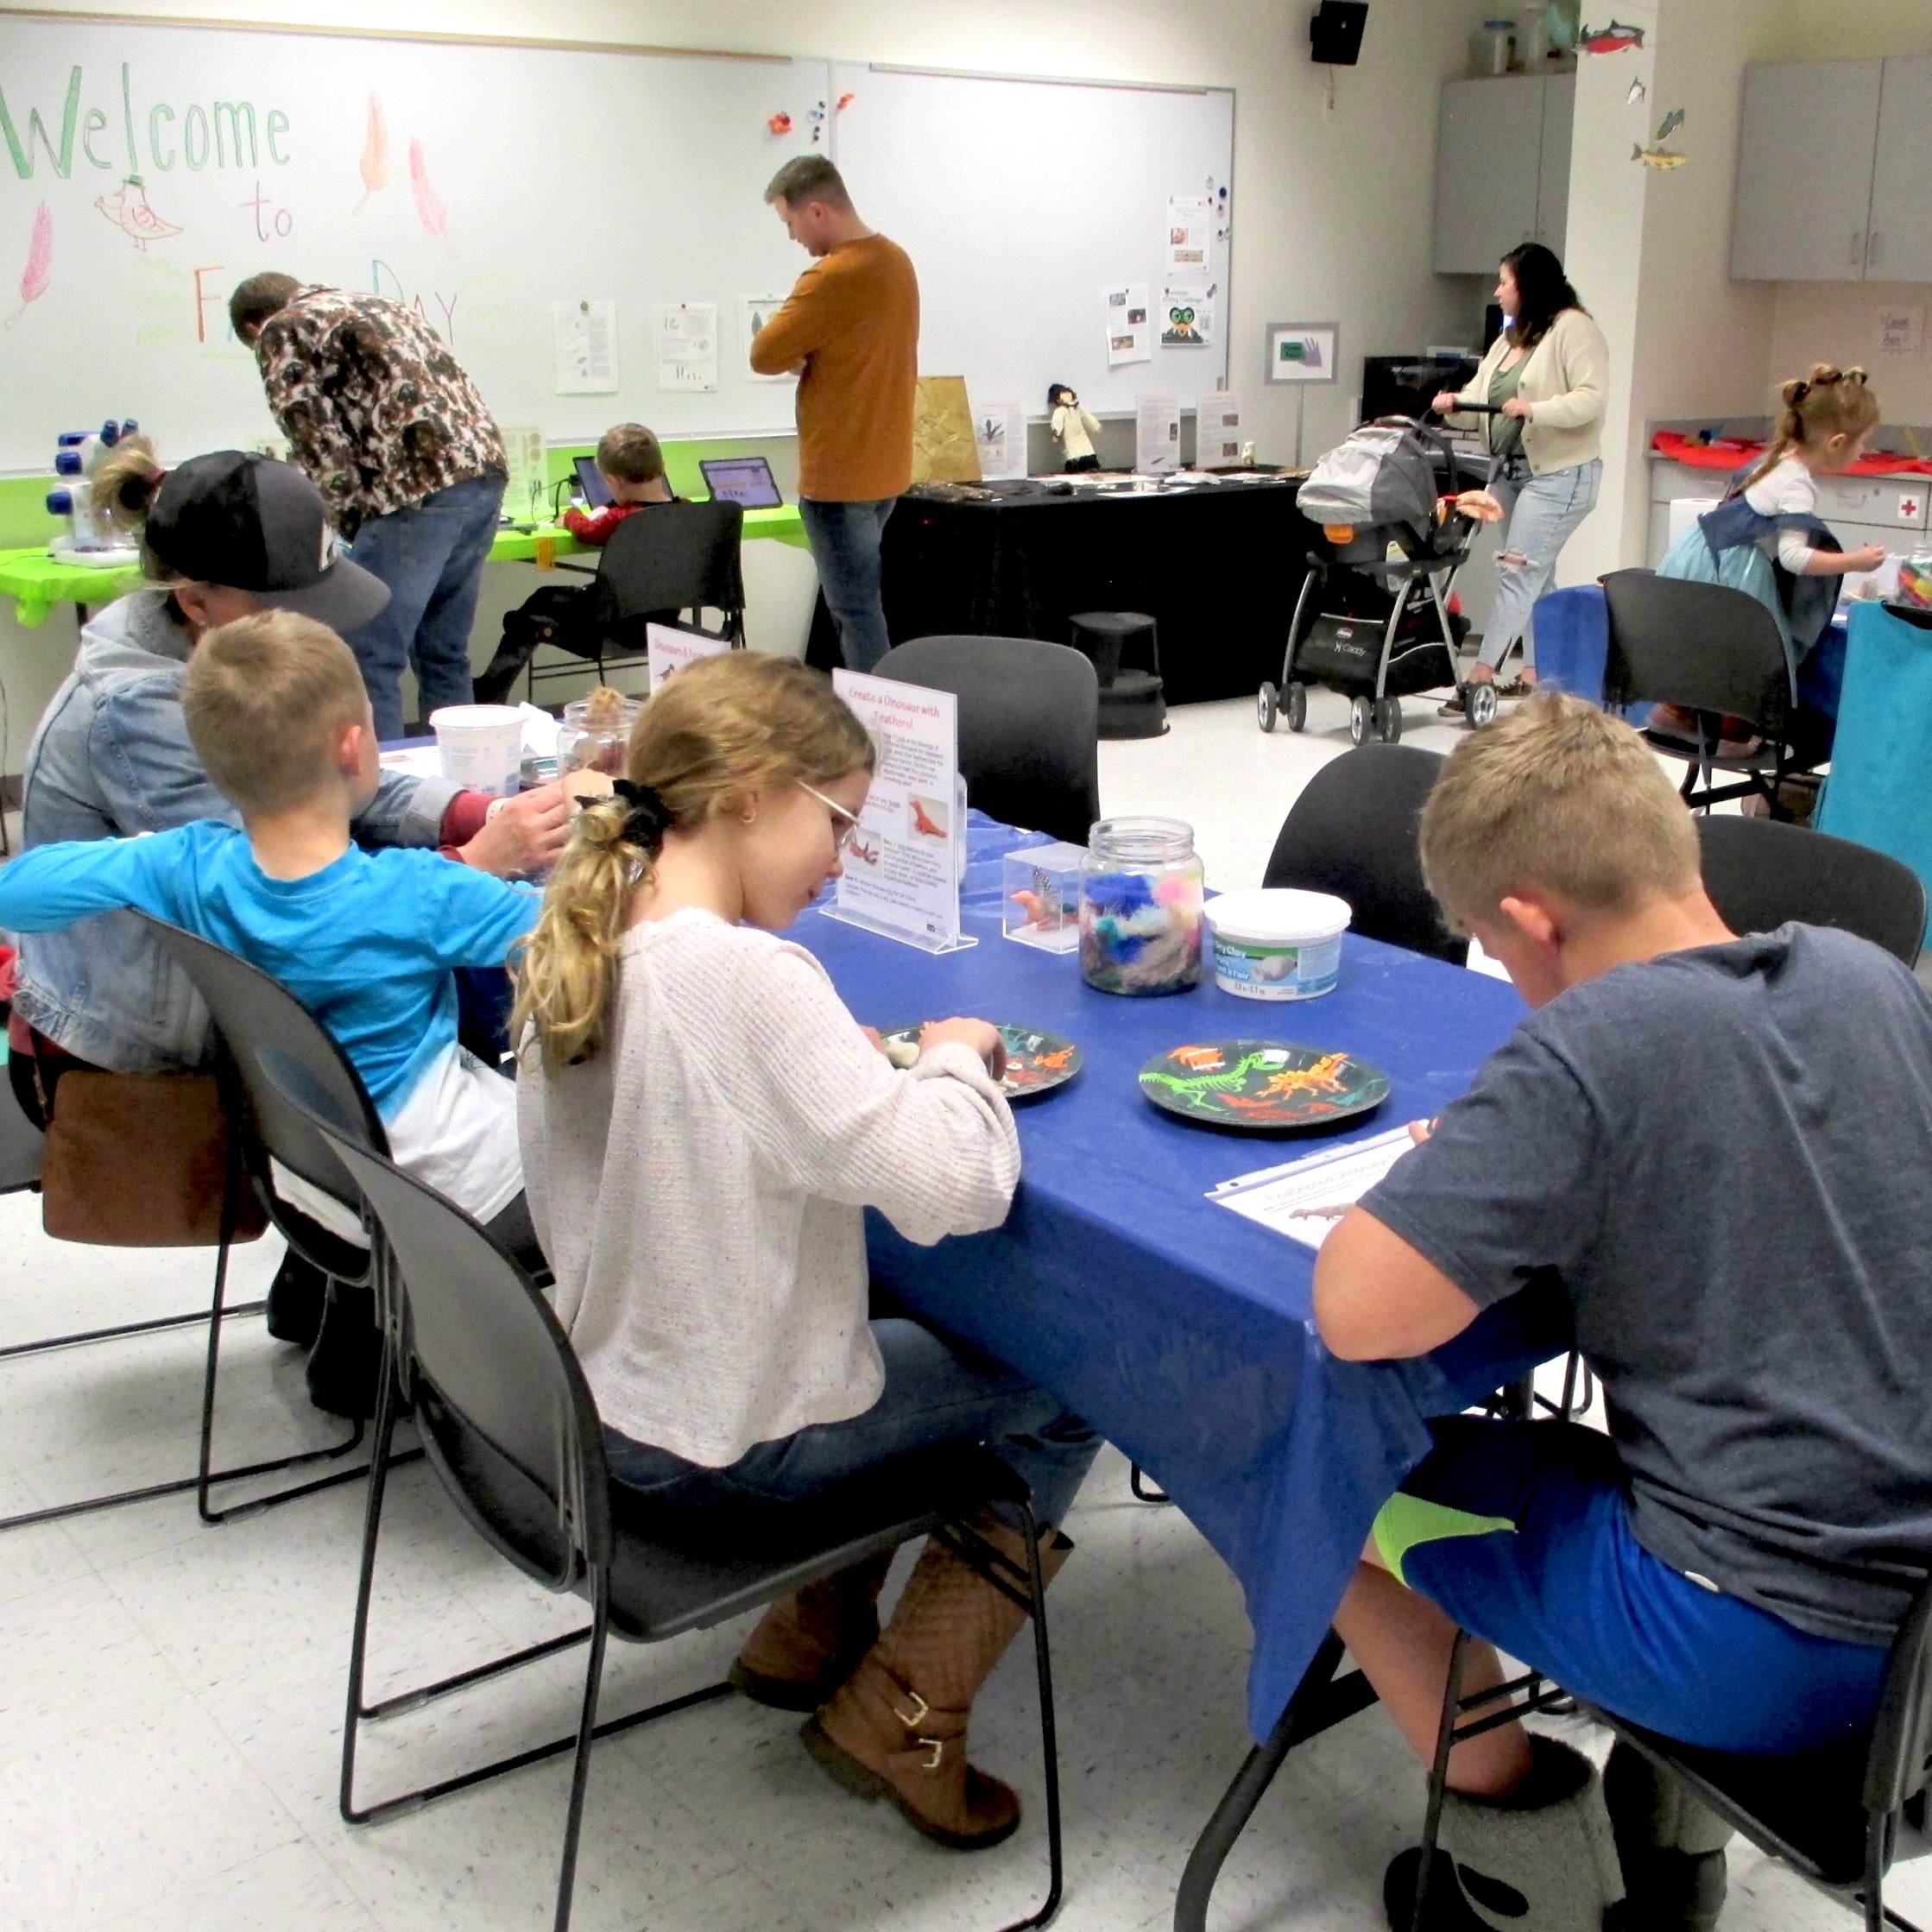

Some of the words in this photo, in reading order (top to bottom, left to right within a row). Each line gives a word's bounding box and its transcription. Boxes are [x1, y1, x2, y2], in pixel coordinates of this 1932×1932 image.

[0, 61, 291, 180] Welcome
[239, 180, 293, 243] to
[849, 686, 876, 704] Create
[884, 694, 919, 713] Dinosaur
[921, 704, 940, 718] with
